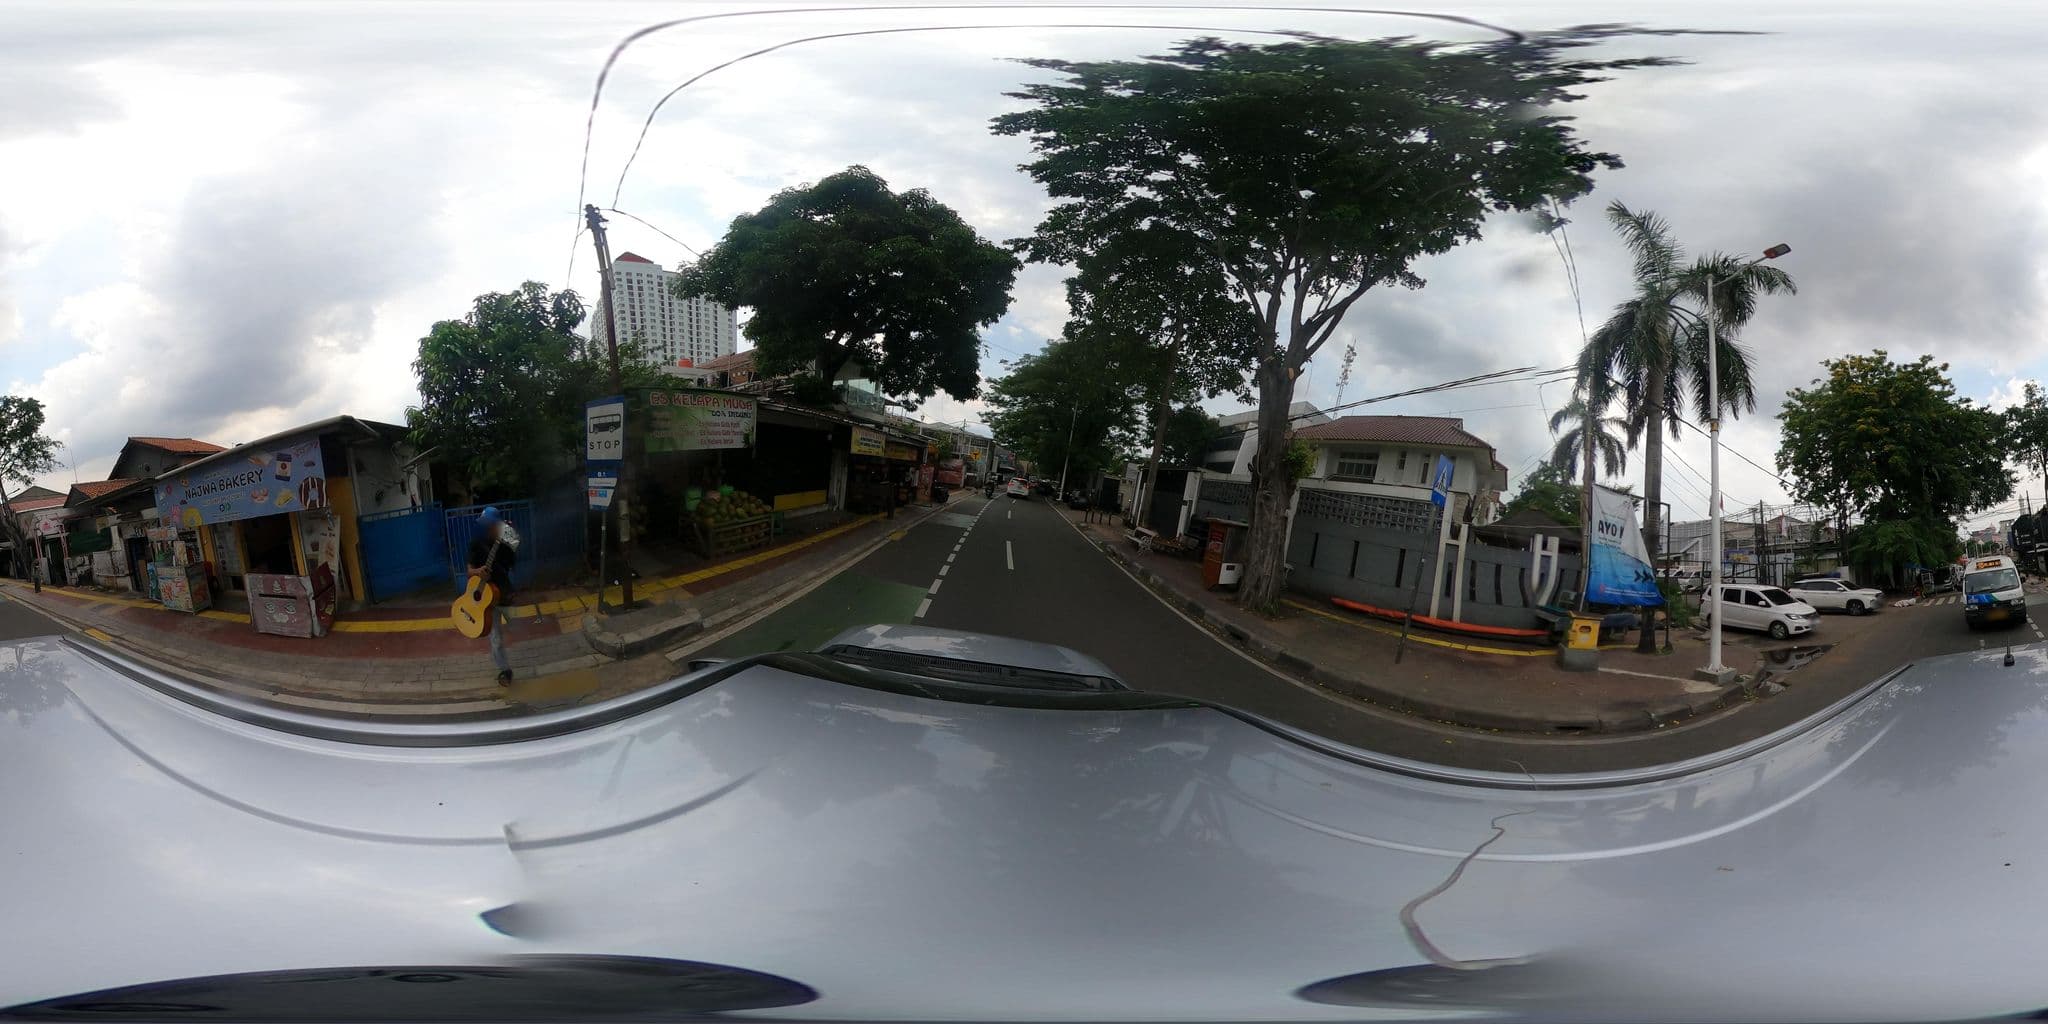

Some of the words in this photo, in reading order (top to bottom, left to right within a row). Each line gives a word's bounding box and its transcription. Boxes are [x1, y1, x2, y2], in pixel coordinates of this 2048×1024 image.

[672, 392, 720, 408] KELAPA
[589, 440, 621, 450] STOP
[185, 482, 217, 500] NAJWA
[218, 469, 263, 491] BAKERY
[1598, 520, 1617, 537] AYO
